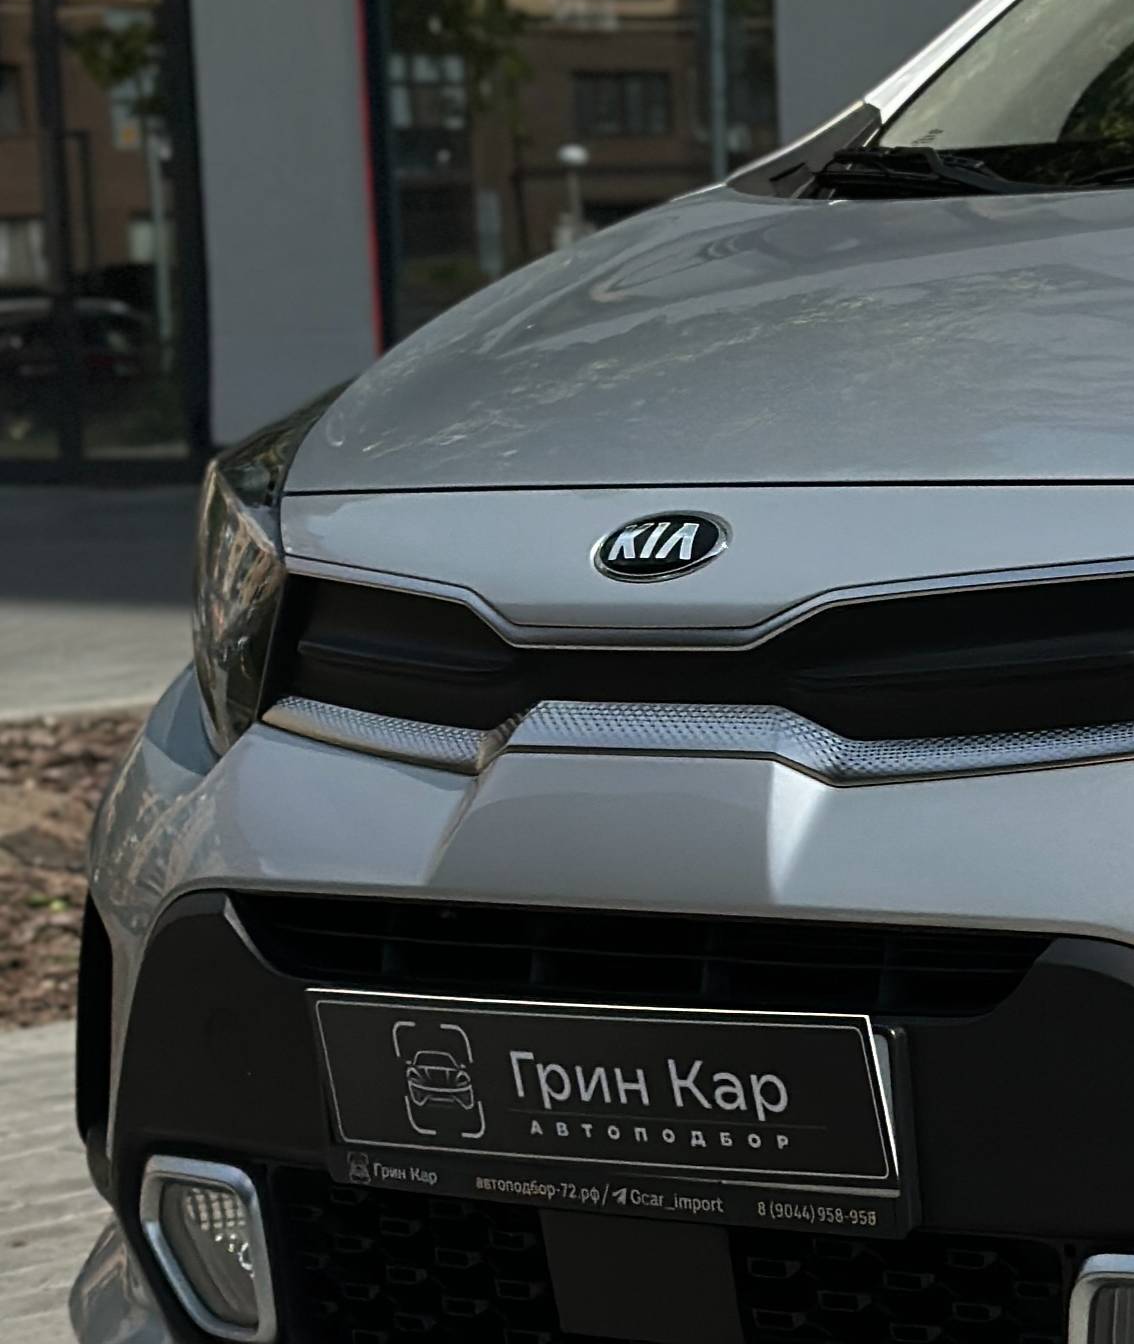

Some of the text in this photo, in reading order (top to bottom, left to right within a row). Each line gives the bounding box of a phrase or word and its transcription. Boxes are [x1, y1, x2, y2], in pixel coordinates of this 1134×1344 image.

[607, 521, 700, 561] KIA
[509, 1050, 789, 1122] Грин Кар
[530, 1120, 789, 1149] АВТОПОДБОР
[373, 1162, 438, 1185] Грин Кар
